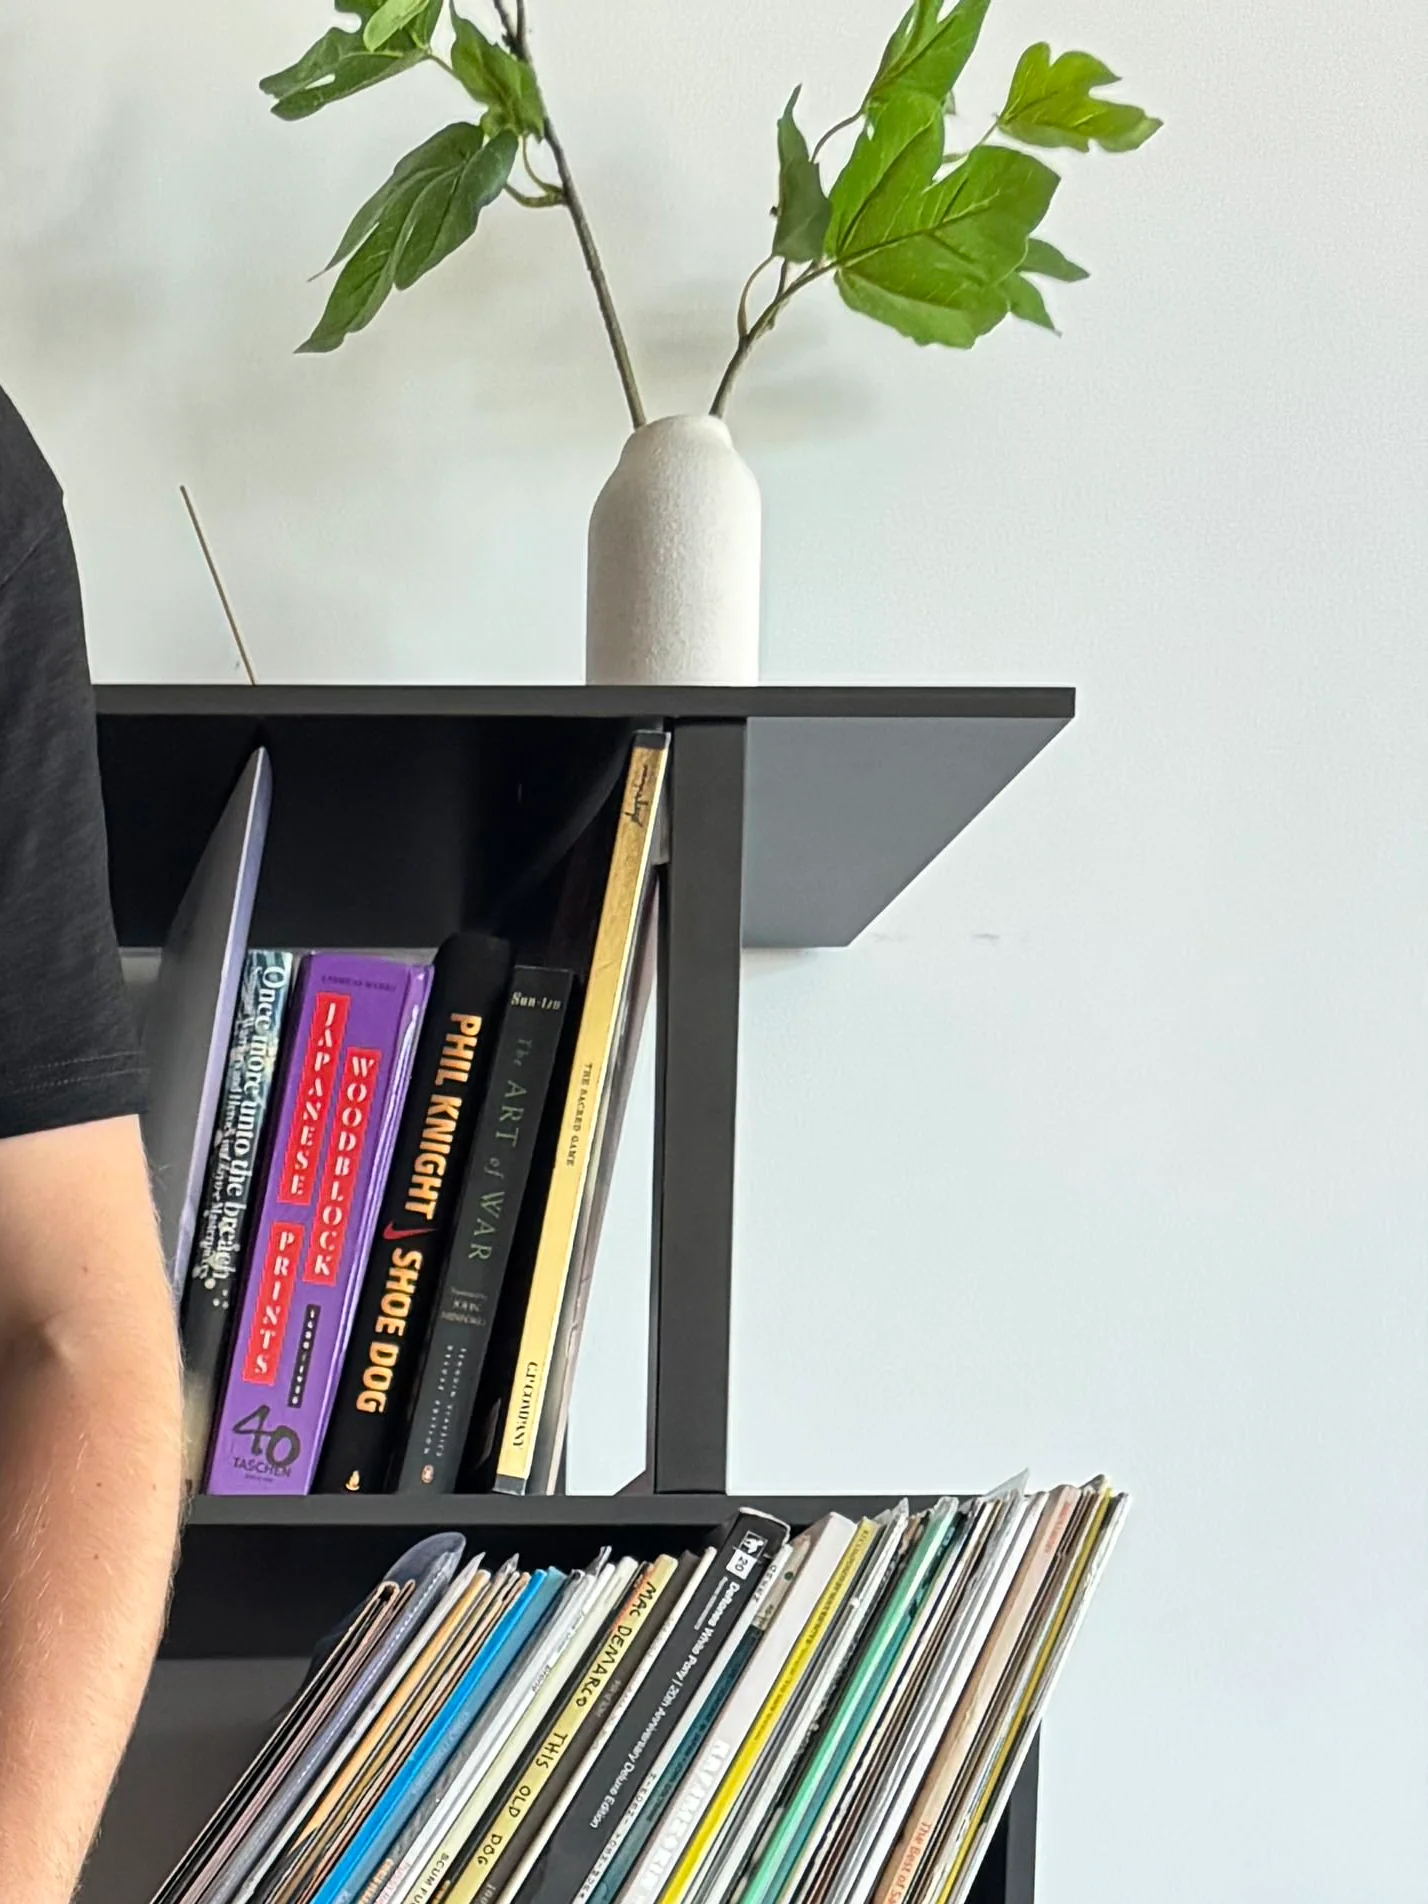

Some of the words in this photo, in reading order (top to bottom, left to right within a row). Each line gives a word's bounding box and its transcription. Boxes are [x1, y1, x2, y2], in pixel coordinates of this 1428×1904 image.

[254, 966, 286, 1036] Once
[244, 1035, 268, 1098] more
[434, 1012, 482, 1087] PHIL
[290, 1002, 336, 1196] JAPANESE
[494, 1079, 528, 1148] ART
[234, 1100, 258, 1157] unto
[226, 1159, 252, 1197] the
[314, 1056, 375, 1276] WOODBLOCK
[404, 1093, 463, 1221] KNIGHT
[484, 1157, 506, 1180] of
[467, 1190, 506, 1262] WAR
[254, 1231, 295, 1374] PRINTS
[374, 1247, 423, 1337] SHOE
[355, 1340, 400, 1415] DOG
[232, 1404, 301, 1467] 40
[630, 1581, 657, 1617] MAC
[689, 1626, 714, 1656] White
[576, 1624, 633, 1708] DEMARCO
[673, 1652, 698, 1681] Pony
[659, 1684, 680, 1708] 20th
[536, 1732, 569, 1769] THIS
[624, 1705, 669, 1764] Anniversary
[509, 1786, 531, 1818] OLD
[606, 1760, 635, 1797] Deluxe
[587, 1793, 616, 1829] Edition
[913, 1820, 932, 1845] The
[426, 1852, 450, 1886] SCUM
[478, 1833, 502, 1866] DOG
[900, 1844, 921, 1874] Best
[895, 1874, 908, 1889] of
